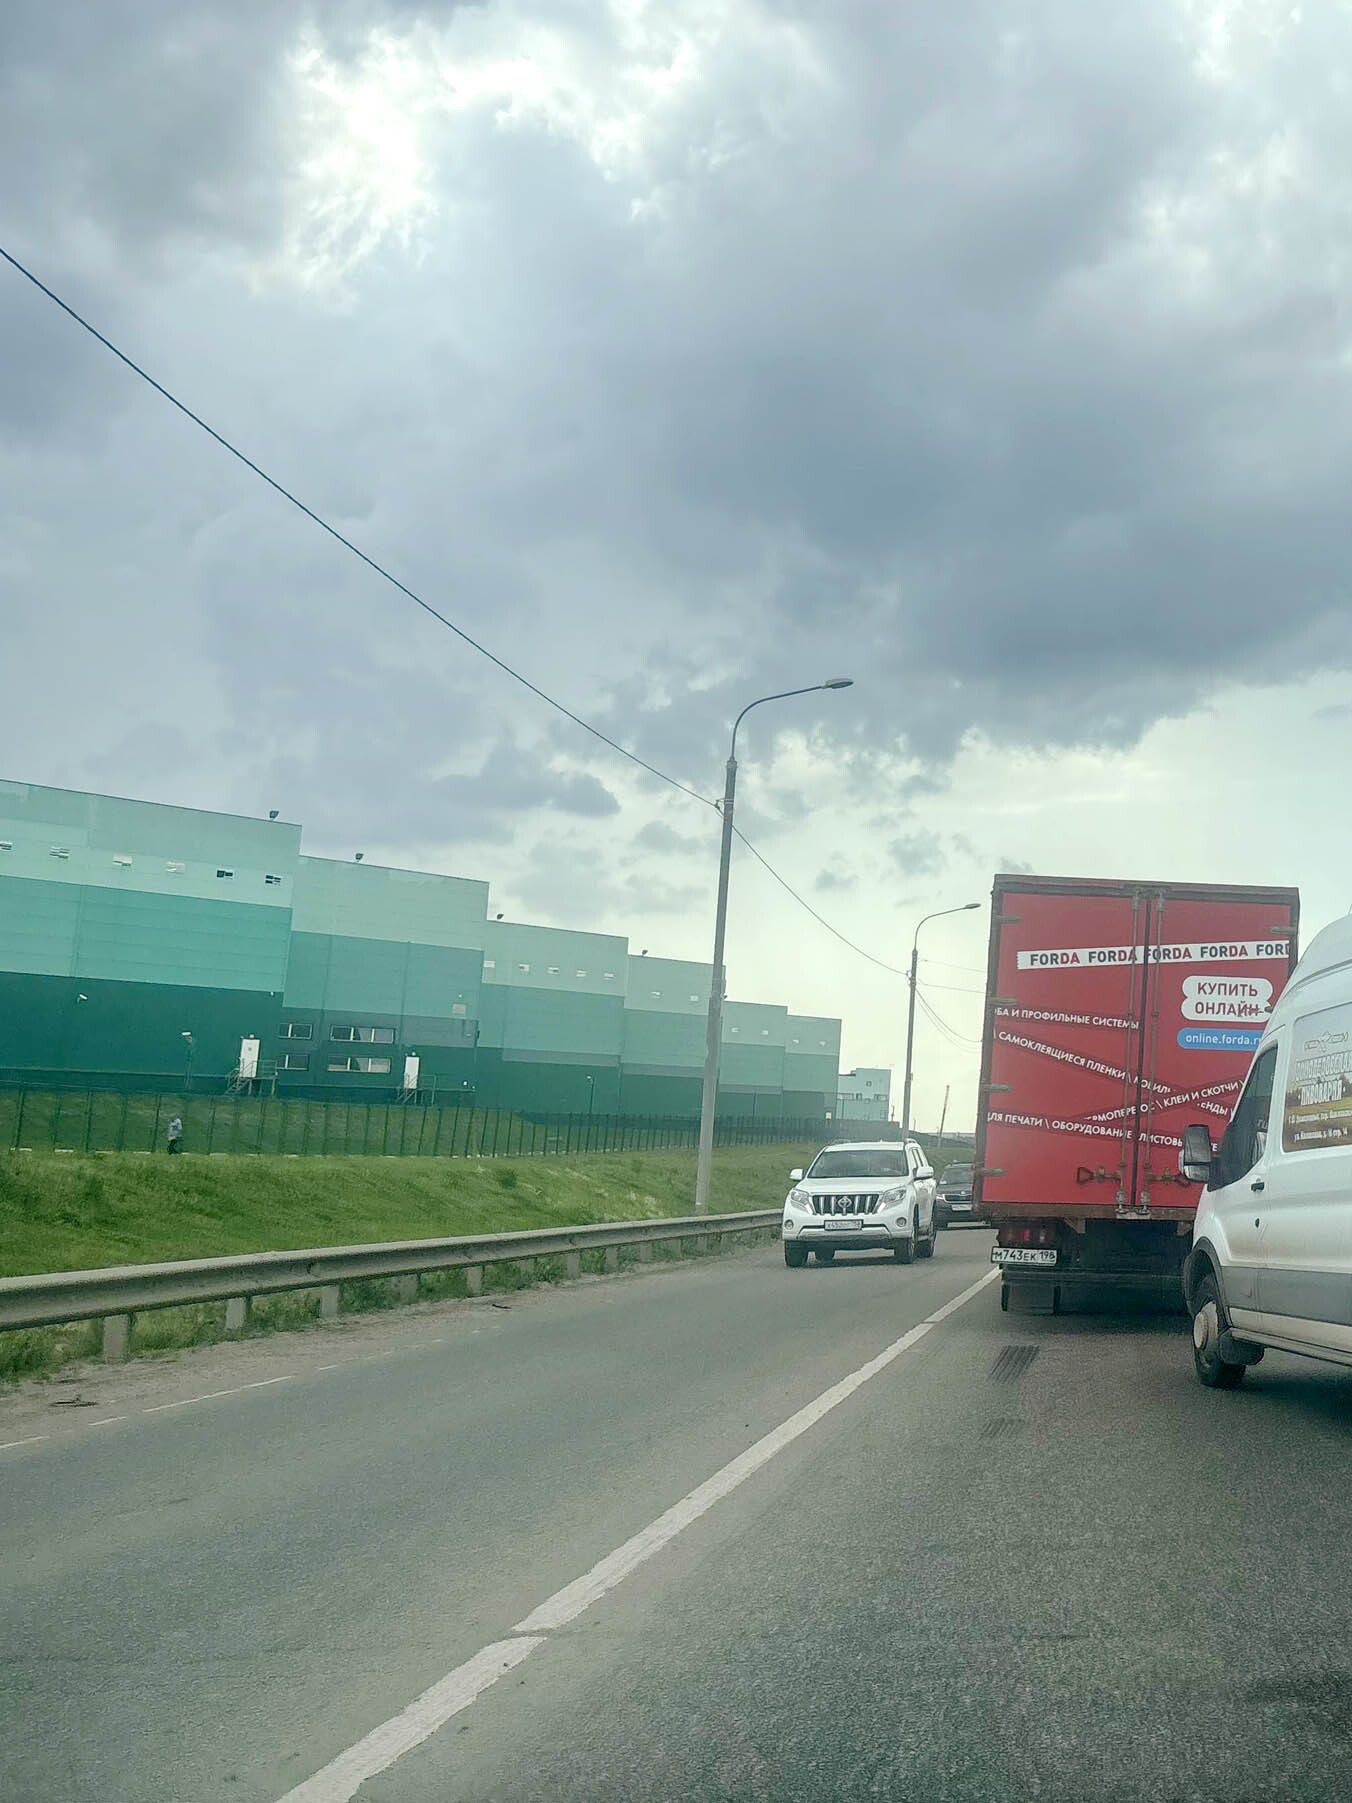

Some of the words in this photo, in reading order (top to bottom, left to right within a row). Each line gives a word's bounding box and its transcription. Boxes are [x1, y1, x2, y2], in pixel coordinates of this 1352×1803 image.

[1030, 953, 1081, 966] FORDA
[1088, 951, 1138, 964] FORDA
[1200, 944, 1249, 959] FORDA
[1197, 982, 1259, 997] КУПИТЬ
[994, 1008, 1009, 1017] БА
[1011, 1009, 1020, 1018] И
[1021, 1009, 1090, 1024] ПРОФИЛЬНЫЕ
[1092, 1016, 1139, 1030] СИСТЕМЫ
[1195, 1000, 1262, 1017] ОНЛАЙН
[998, 1031, 1085, 1066] САМОКЛЕЯЩИЕСЯ
[1086, 1060, 1126, 1080] ПЛЕНКИ
[1163, 1092, 1190, 1107] КЛЕИ
[1191, 1090, 1200, 1100] И
[1200, 1081, 1239, 1098] СКОТЧИ
[1005, 1114, 1043, 1128] ПЕЧАТИ
[1051, 1120, 1133, 1140] ОБОРУДОВАНИЕ
